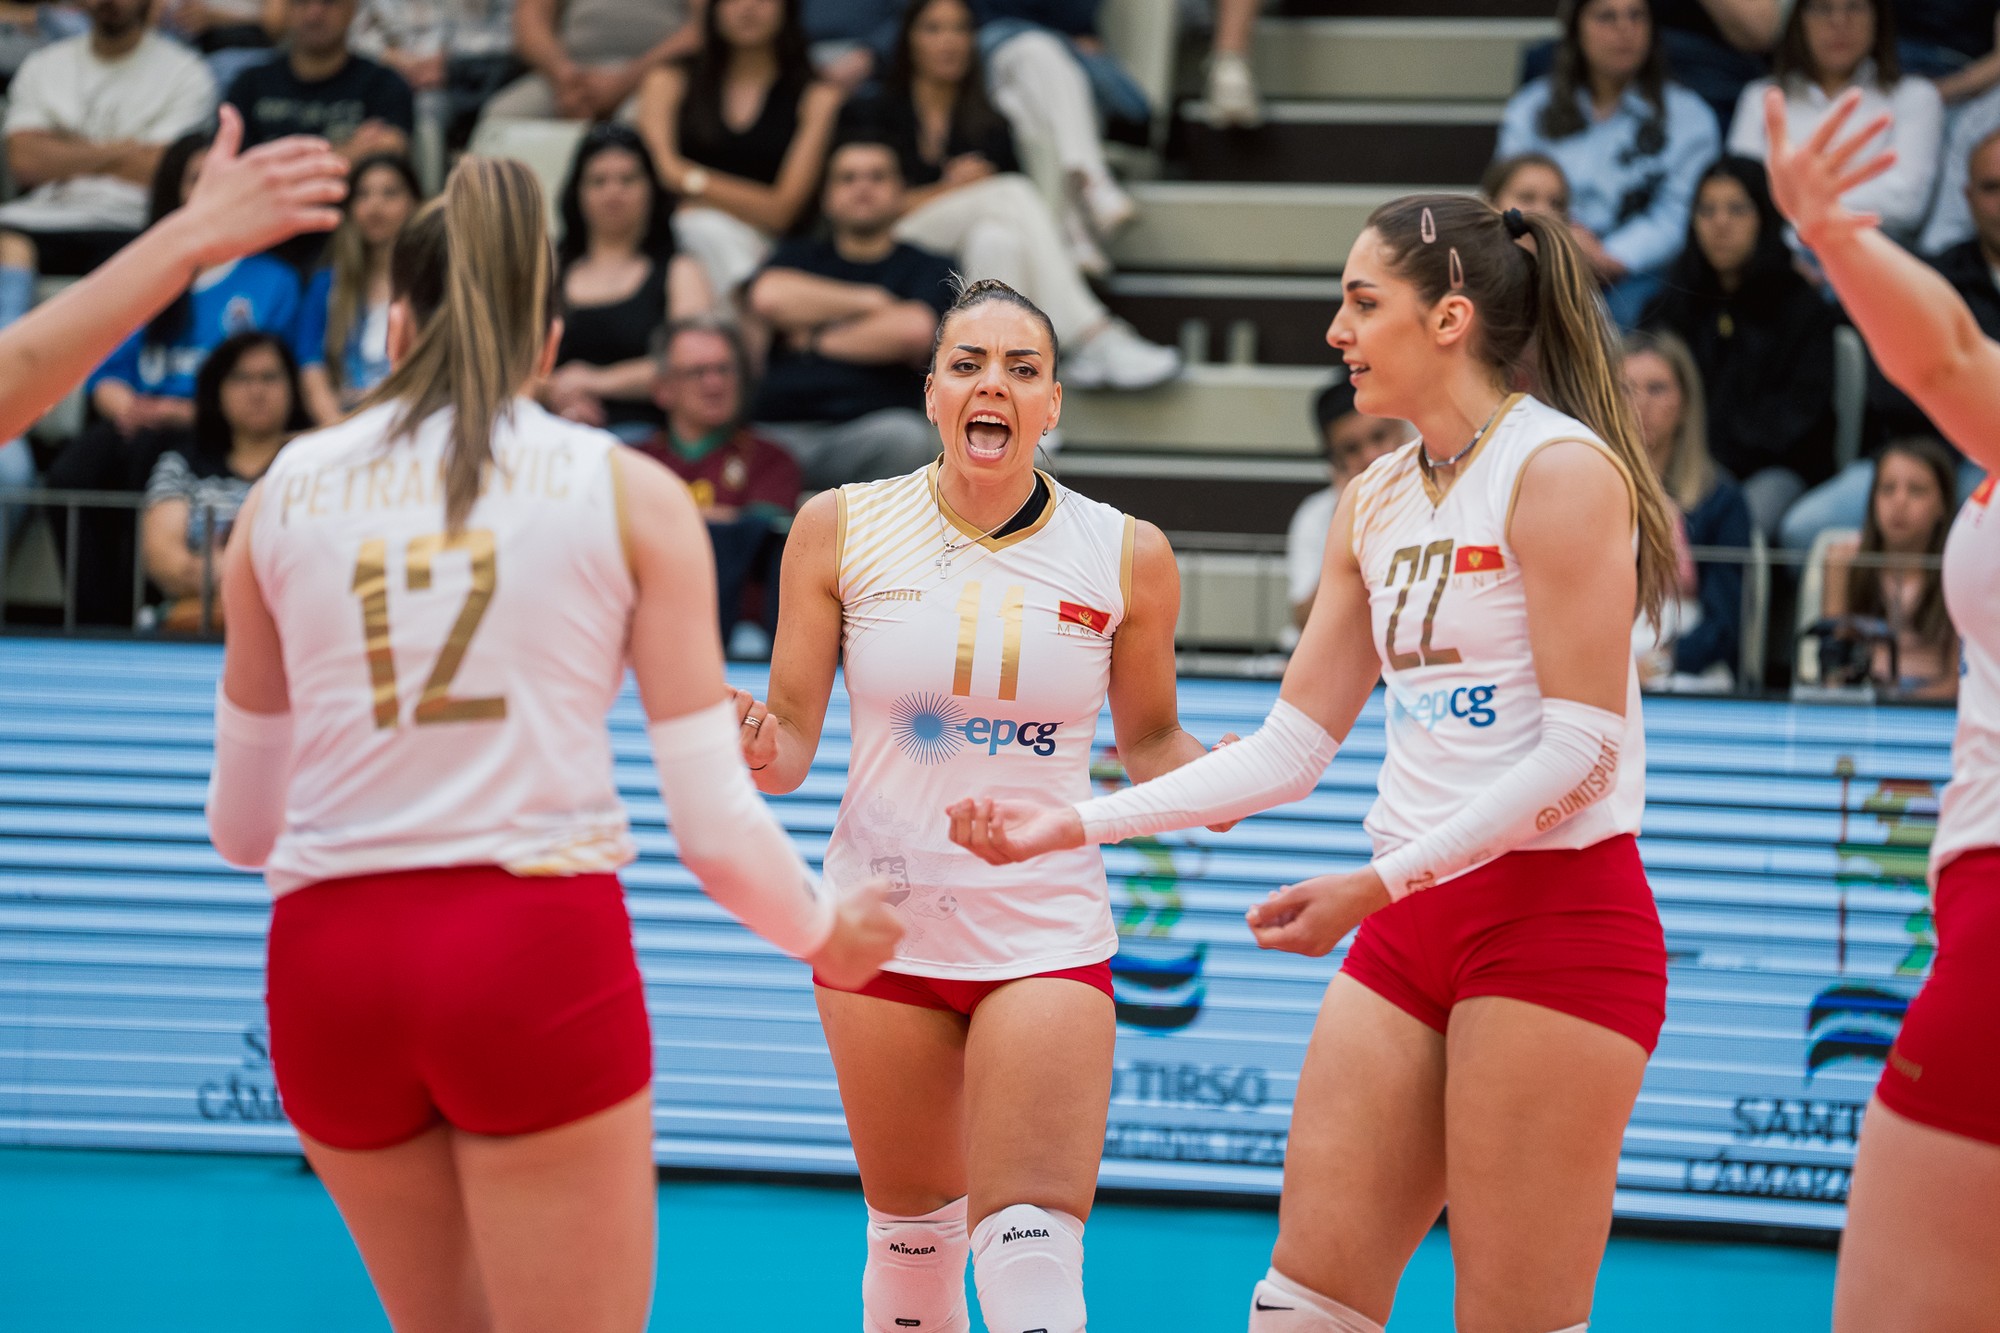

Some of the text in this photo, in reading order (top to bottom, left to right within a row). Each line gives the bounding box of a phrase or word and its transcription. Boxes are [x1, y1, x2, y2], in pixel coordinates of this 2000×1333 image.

[350, 528, 508, 730] 12
[952, 580, 1026, 701] 11
[1384, 538, 1463, 671] 22
[956, 717, 1064, 756] epcg
[1409, 684, 1498, 732] epcg
[1558, 735, 1620, 816] UNITSPORT
[1734, 1097, 1868, 1145] SANT
